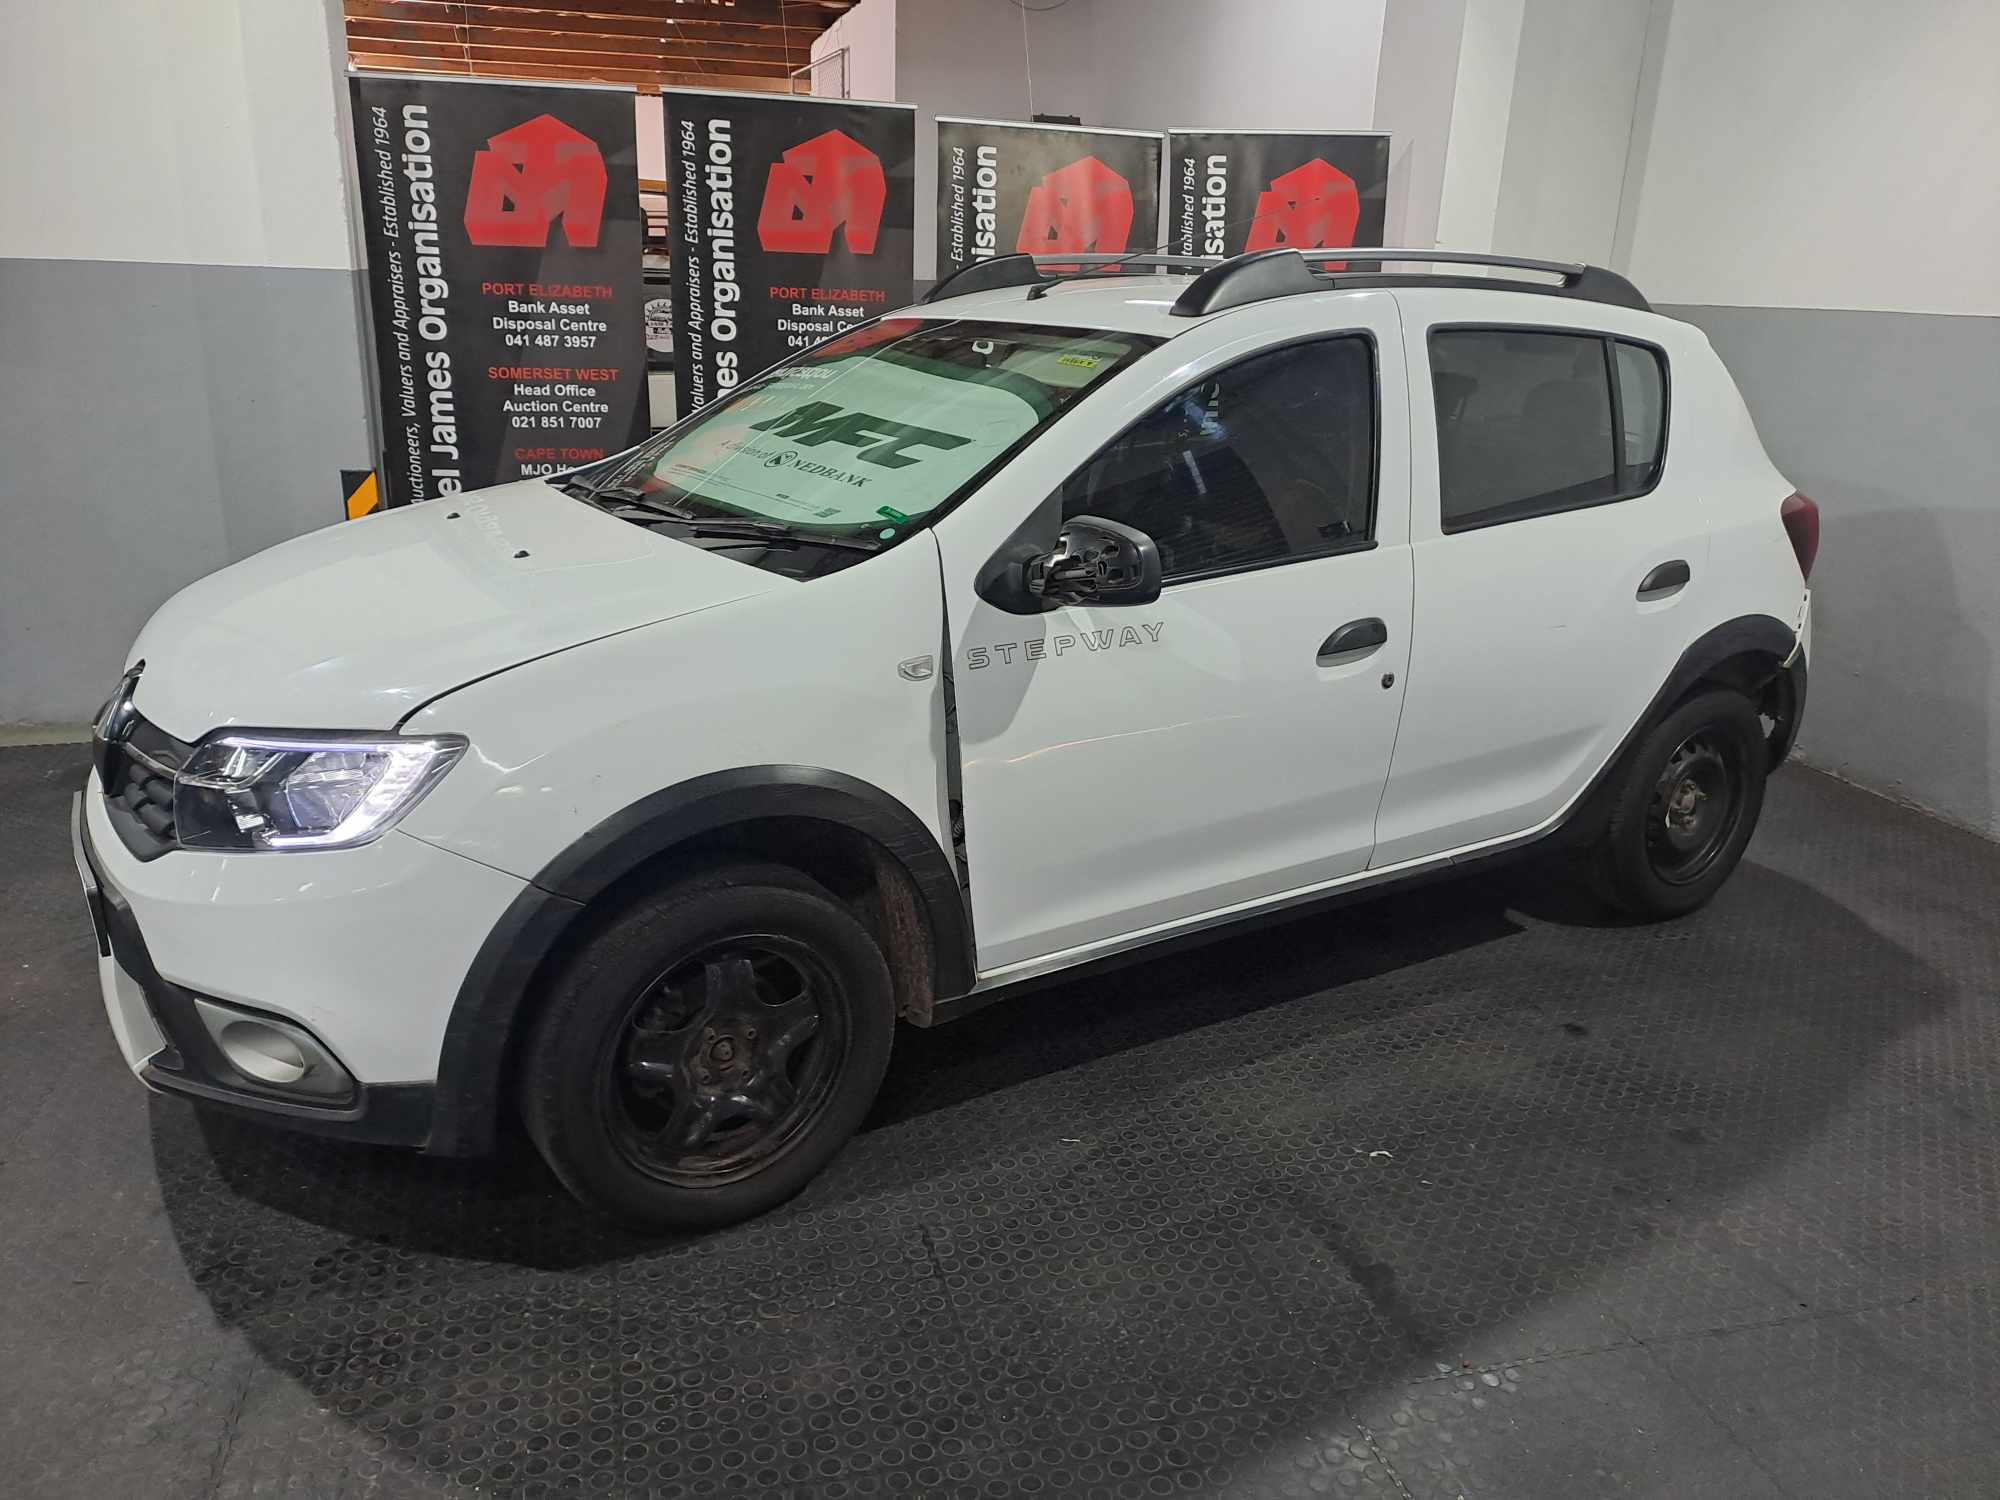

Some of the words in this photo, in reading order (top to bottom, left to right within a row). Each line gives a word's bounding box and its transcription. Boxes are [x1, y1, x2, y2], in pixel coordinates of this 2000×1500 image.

[371, 106, 391, 144] 1964
[680, 120, 695, 156] 1964
[952, 146, 965, 180] 1964
[1183, 158, 1196, 191] 1964
[374, 149, 399, 238] Established
[681, 160, 699, 244] Established
[971, 145, 997, 262] isation
[950, 184, 965, 262] Established
[1200, 155, 1227, 272] isation
[1180, 194, 1194, 269] tablished
[387, 251, 411, 330] Appraisers
[482, 283, 524, 295] PORT
[528, 284, 613, 298] ELIZABETH
[685, 256, 704, 330] Appraisers
[769, 287, 808, 298] PORT
[811, 288, 886, 301] ELIZABETH
[508, 300, 546, 313] Bank
[549, 301, 591, 315] Asset
[792, 303, 825, 316] Bank
[828, 304, 865, 317] Asset
[492, 317, 556, 332] Disposal
[559, 318, 607, 331] Centre
[777, 319, 833, 333] Disposal
[392, 332, 411, 361] and
[505, 334, 530, 346] 041
[534, 335, 560, 347] 487
[563, 335, 597, 348] 3957
[687, 332, 703, 360] and
[787, 336, 809, 346] 041
[488, 367, 572, 379] SOMERSET
[575, 368, 619, 380] WEST
[715, 351, 739, 398] es
[399, 364, 417, 417] Valuers
[425, 351, 459, 460] James
[513, 383, 550, 395] Head
[554, 384, 596, 397] Office
[503, 400, 558, 412] Auction
[562, 401, 609, 413] Centre
[511, 416, 536, 428] 021
[541, 416, 564, 428] 851
[569, 417, 602, 428] 7007
[749, 401, 972, 469] MFC
[514, 448, 556, 460] CAPE
[560, 448, 604, 460] TOWN
[520, 463, 552, 476] MJO
[787, 459, 872, 487] NEDBANK
[966, 621, 1164, 670] STEPWAY
